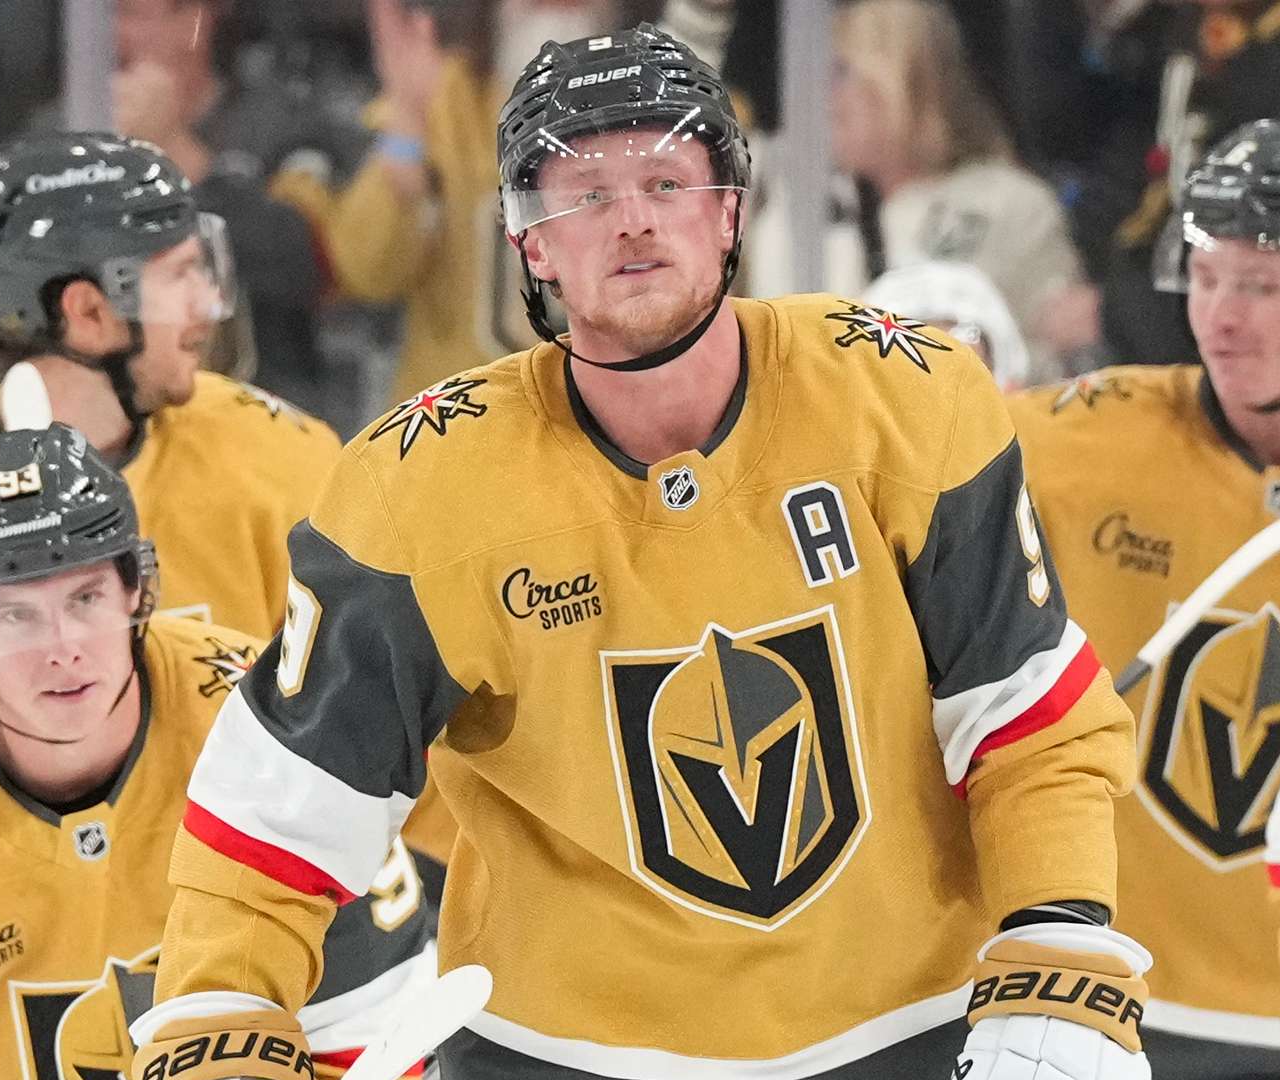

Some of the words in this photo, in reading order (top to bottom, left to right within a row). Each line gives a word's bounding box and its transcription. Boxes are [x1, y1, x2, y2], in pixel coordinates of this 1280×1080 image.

[567, 64, 642, 90] BAUER
[779, 480, 861, 589] A
[501, 567, 598, 620] Circa
[538, 595, 603, 631] SPORTS
[966, 970, 1145, 1033] BAUER
